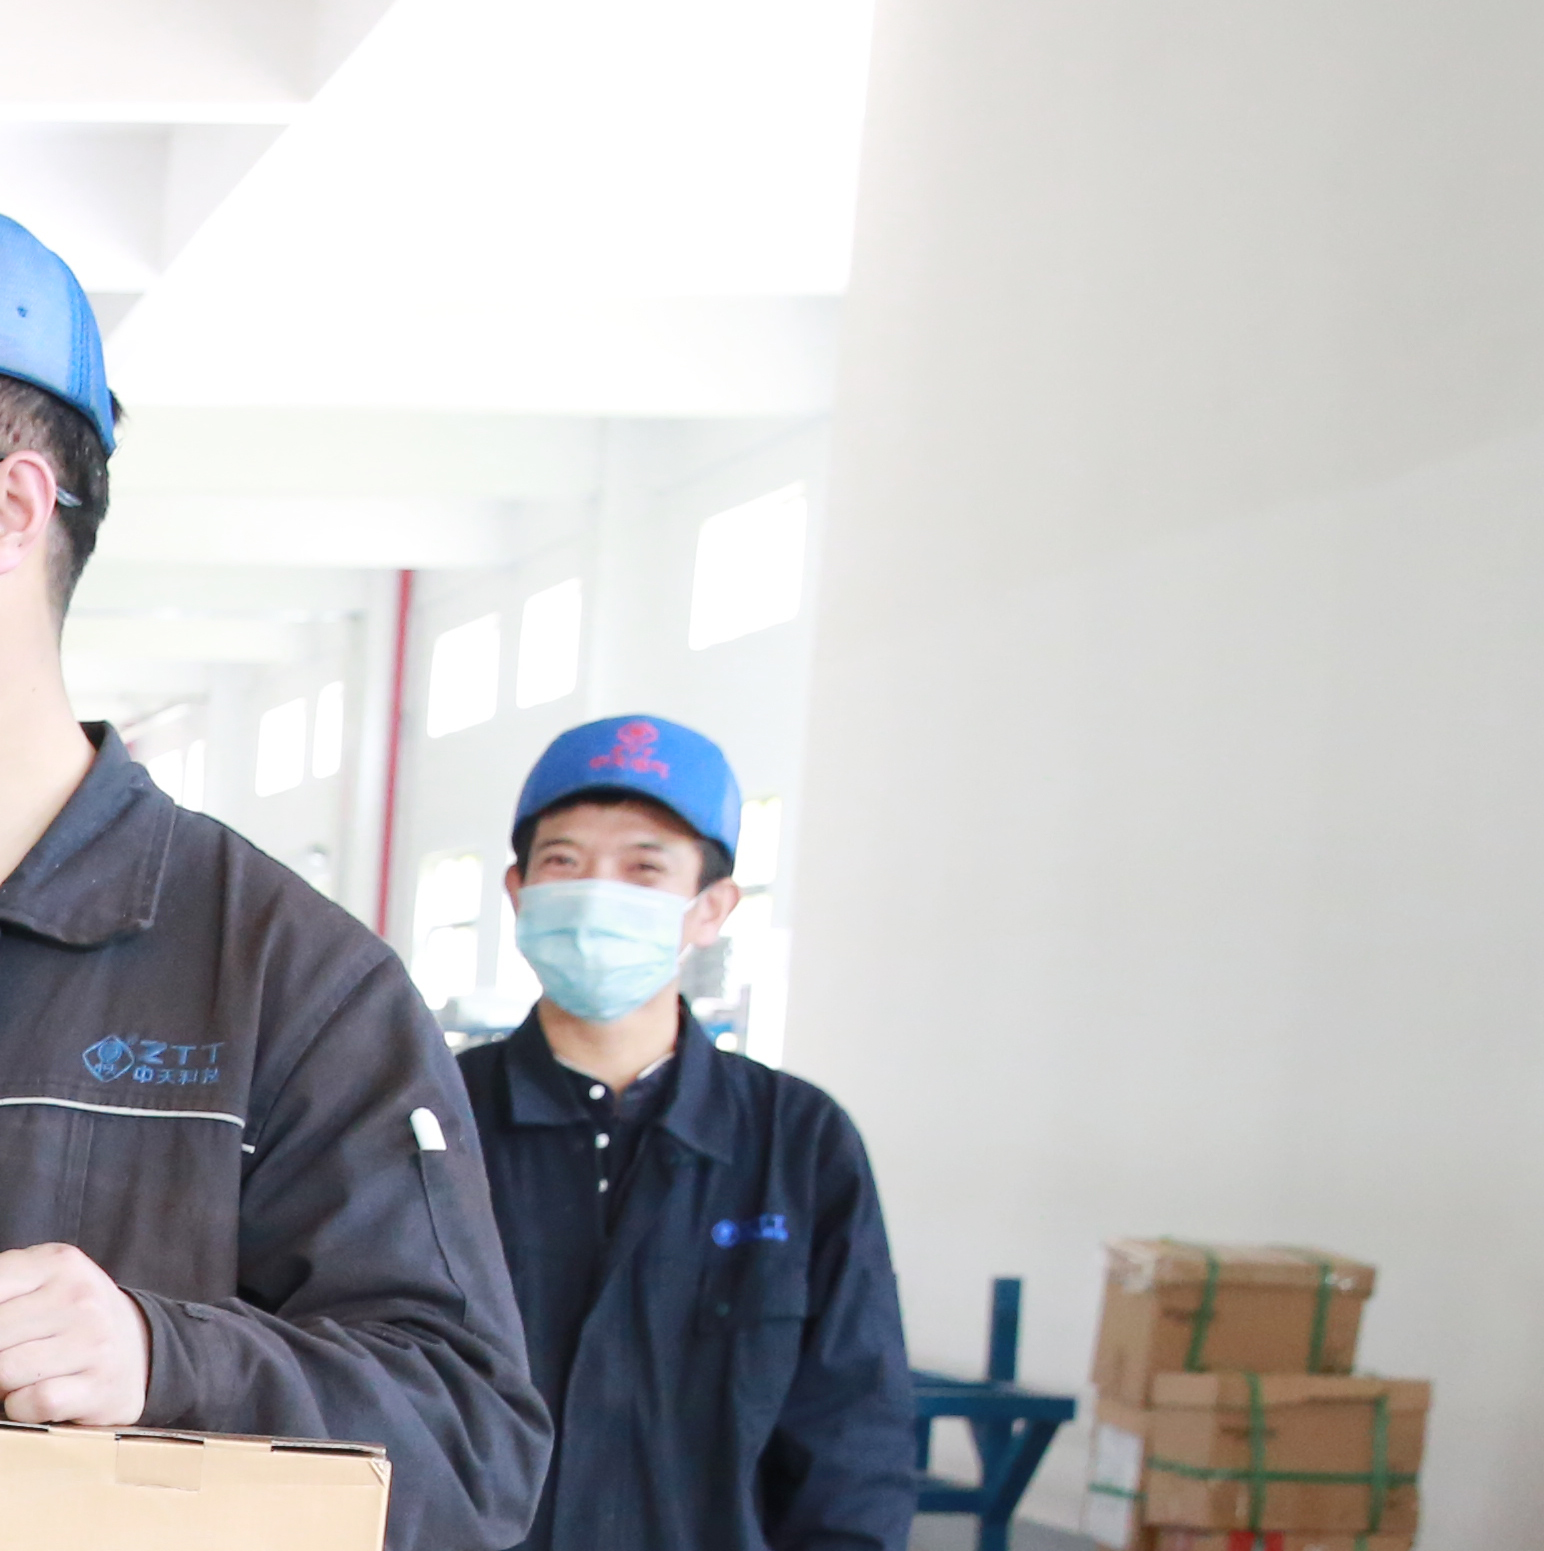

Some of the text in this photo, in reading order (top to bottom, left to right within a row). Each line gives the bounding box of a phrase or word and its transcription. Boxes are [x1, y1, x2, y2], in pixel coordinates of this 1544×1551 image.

[138, 1039, 226, 1066] ZTT
[133, 1064, 221, 1086] 中天科技
